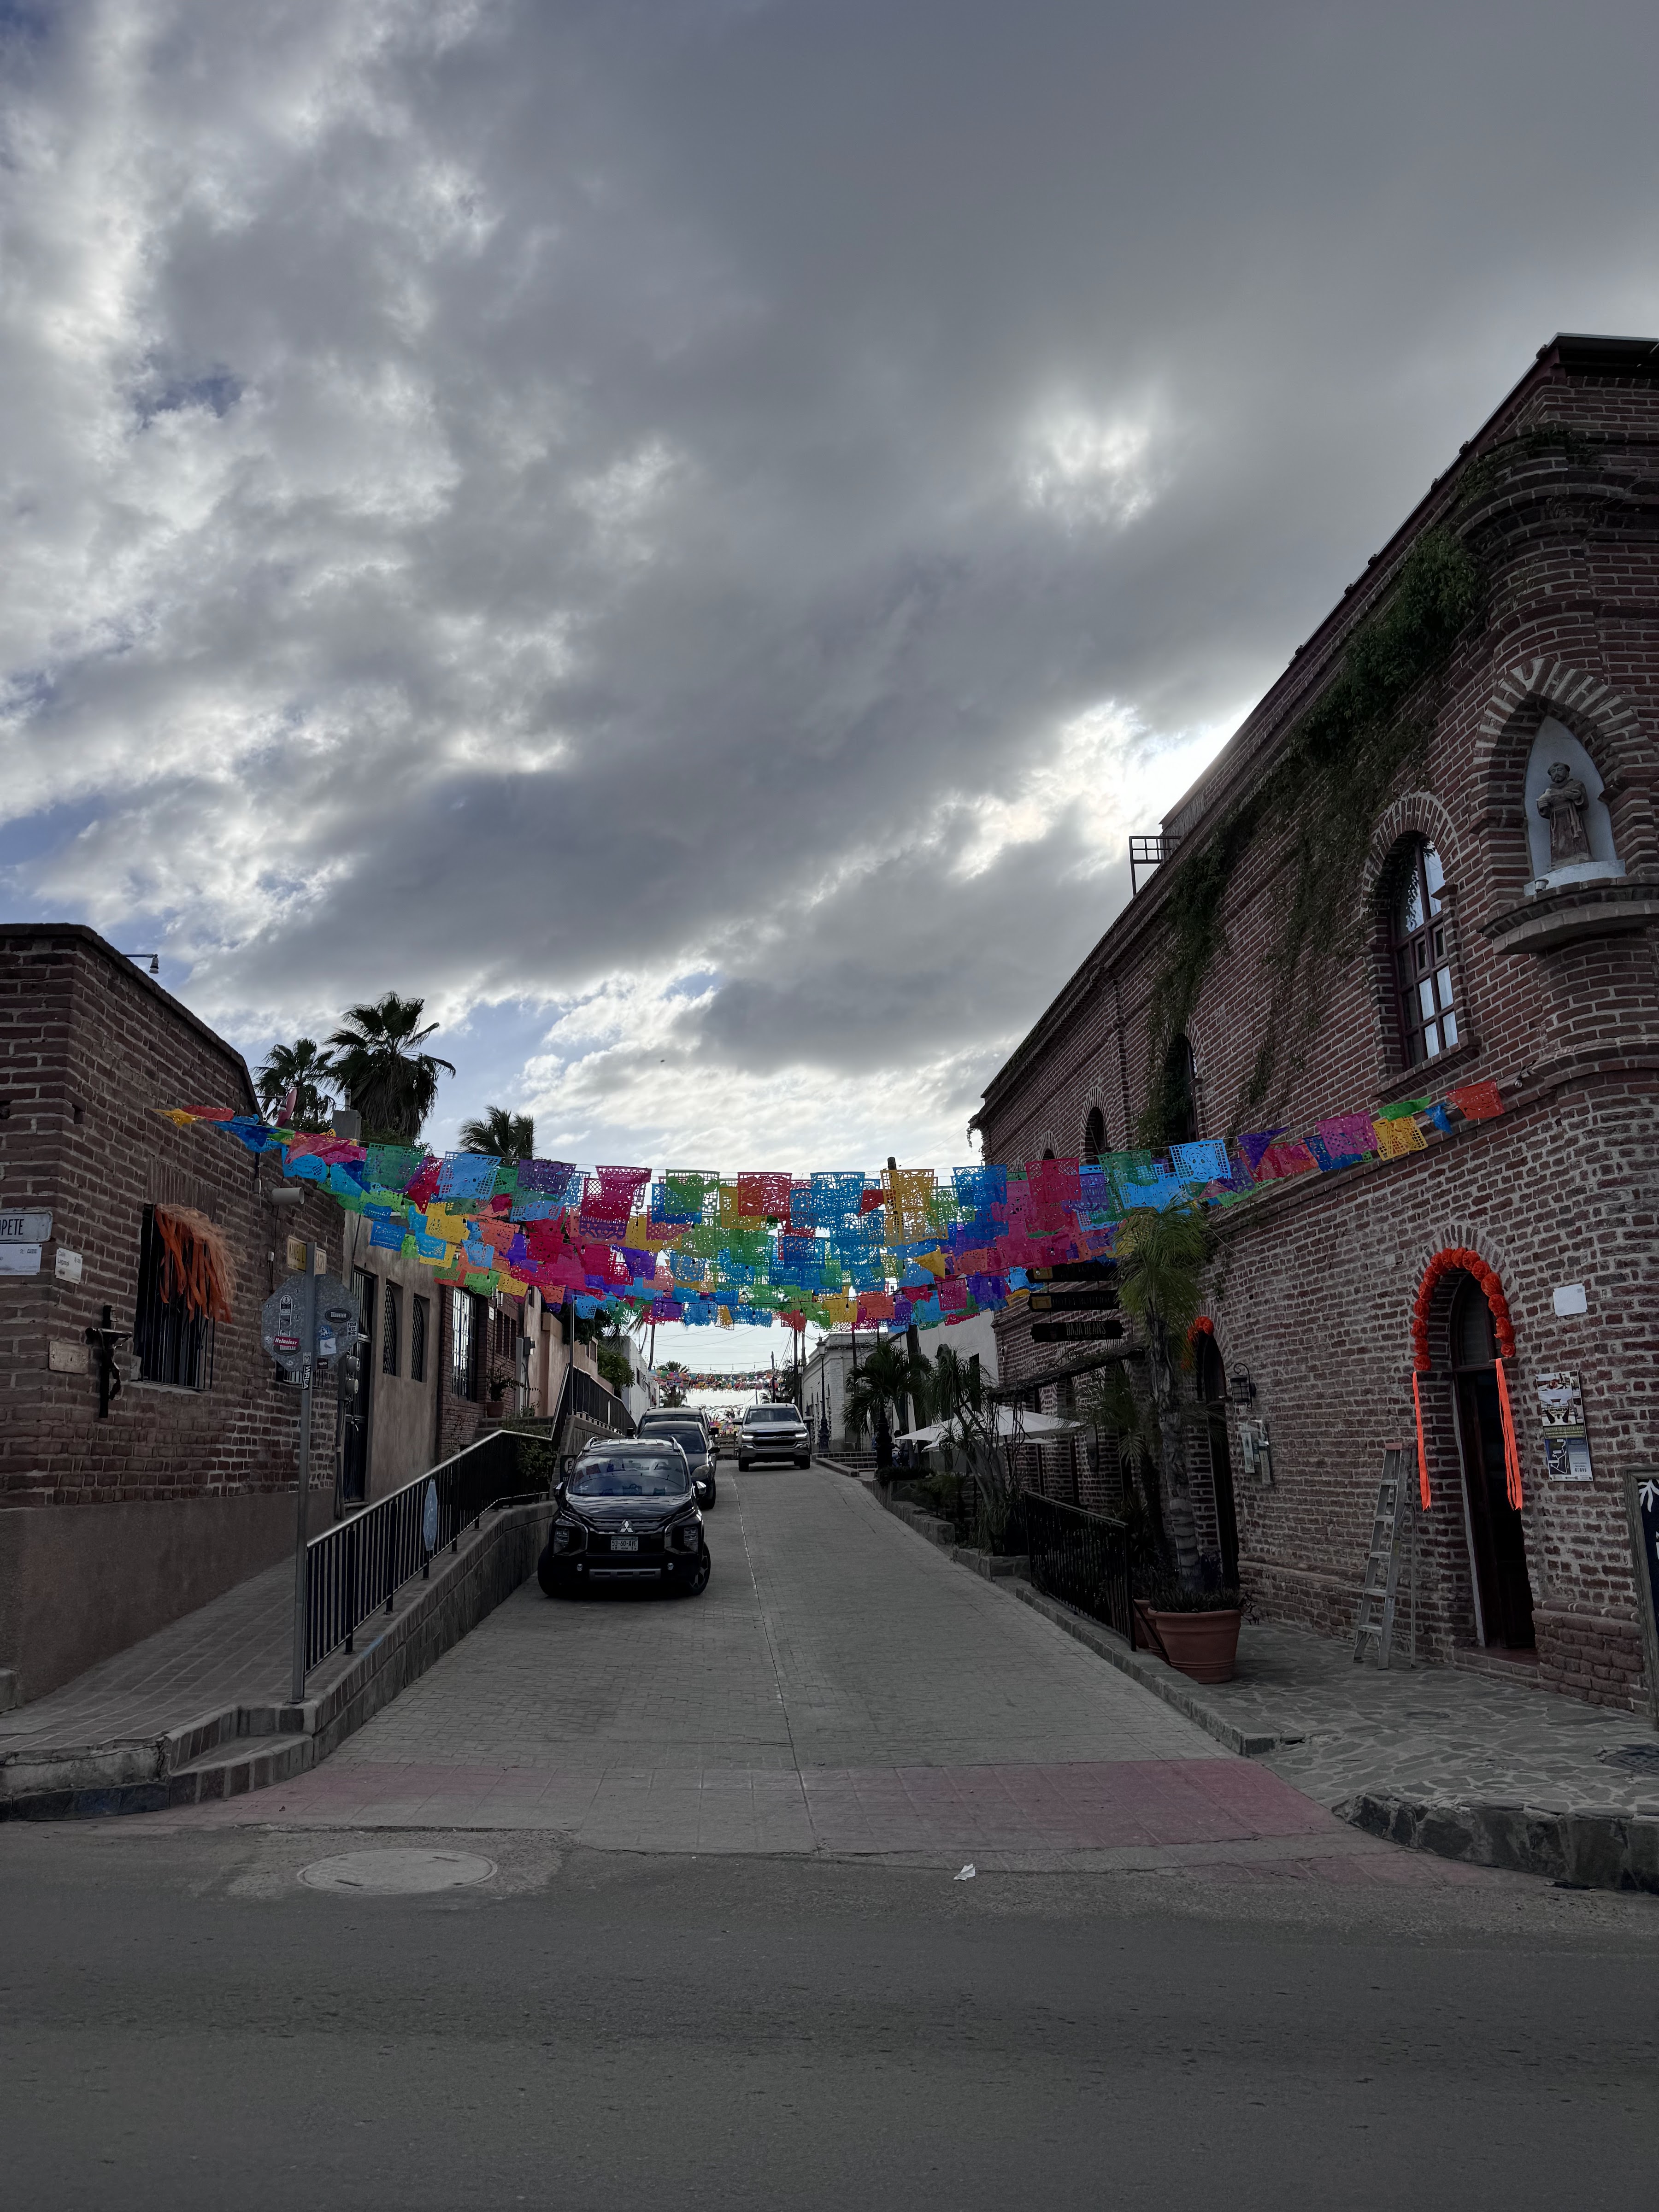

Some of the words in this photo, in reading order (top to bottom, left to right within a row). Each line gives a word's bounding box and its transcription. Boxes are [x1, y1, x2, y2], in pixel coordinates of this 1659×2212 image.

[0, 1219, 24, 1235] PETE
[1066, 1323, 1083, 1336] BAJA
[1084, 1321, 1106, 1335] BEANS
